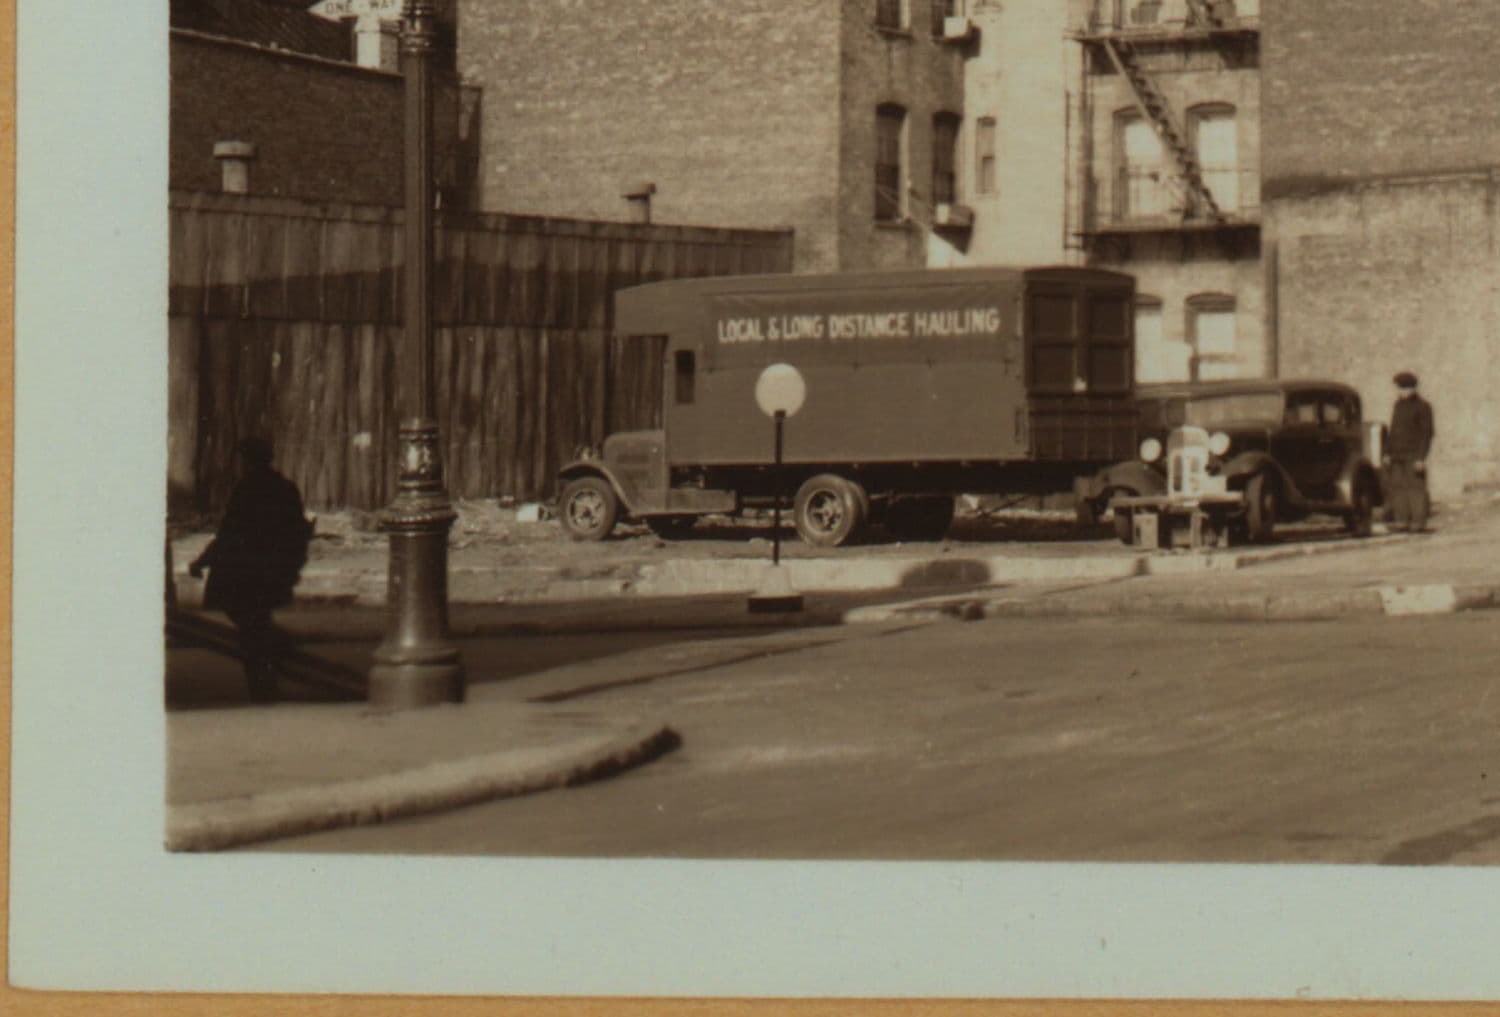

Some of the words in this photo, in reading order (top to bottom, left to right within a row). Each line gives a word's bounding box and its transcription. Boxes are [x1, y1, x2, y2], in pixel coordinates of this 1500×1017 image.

[718, 318, 765, 343] LOCAL
[767, 316, 781, 340] &
[783, 315, 825, 340] LONG
[829, 312, 910, 340] DISTANCE
[914, 307, 1001, 337] HAULING
